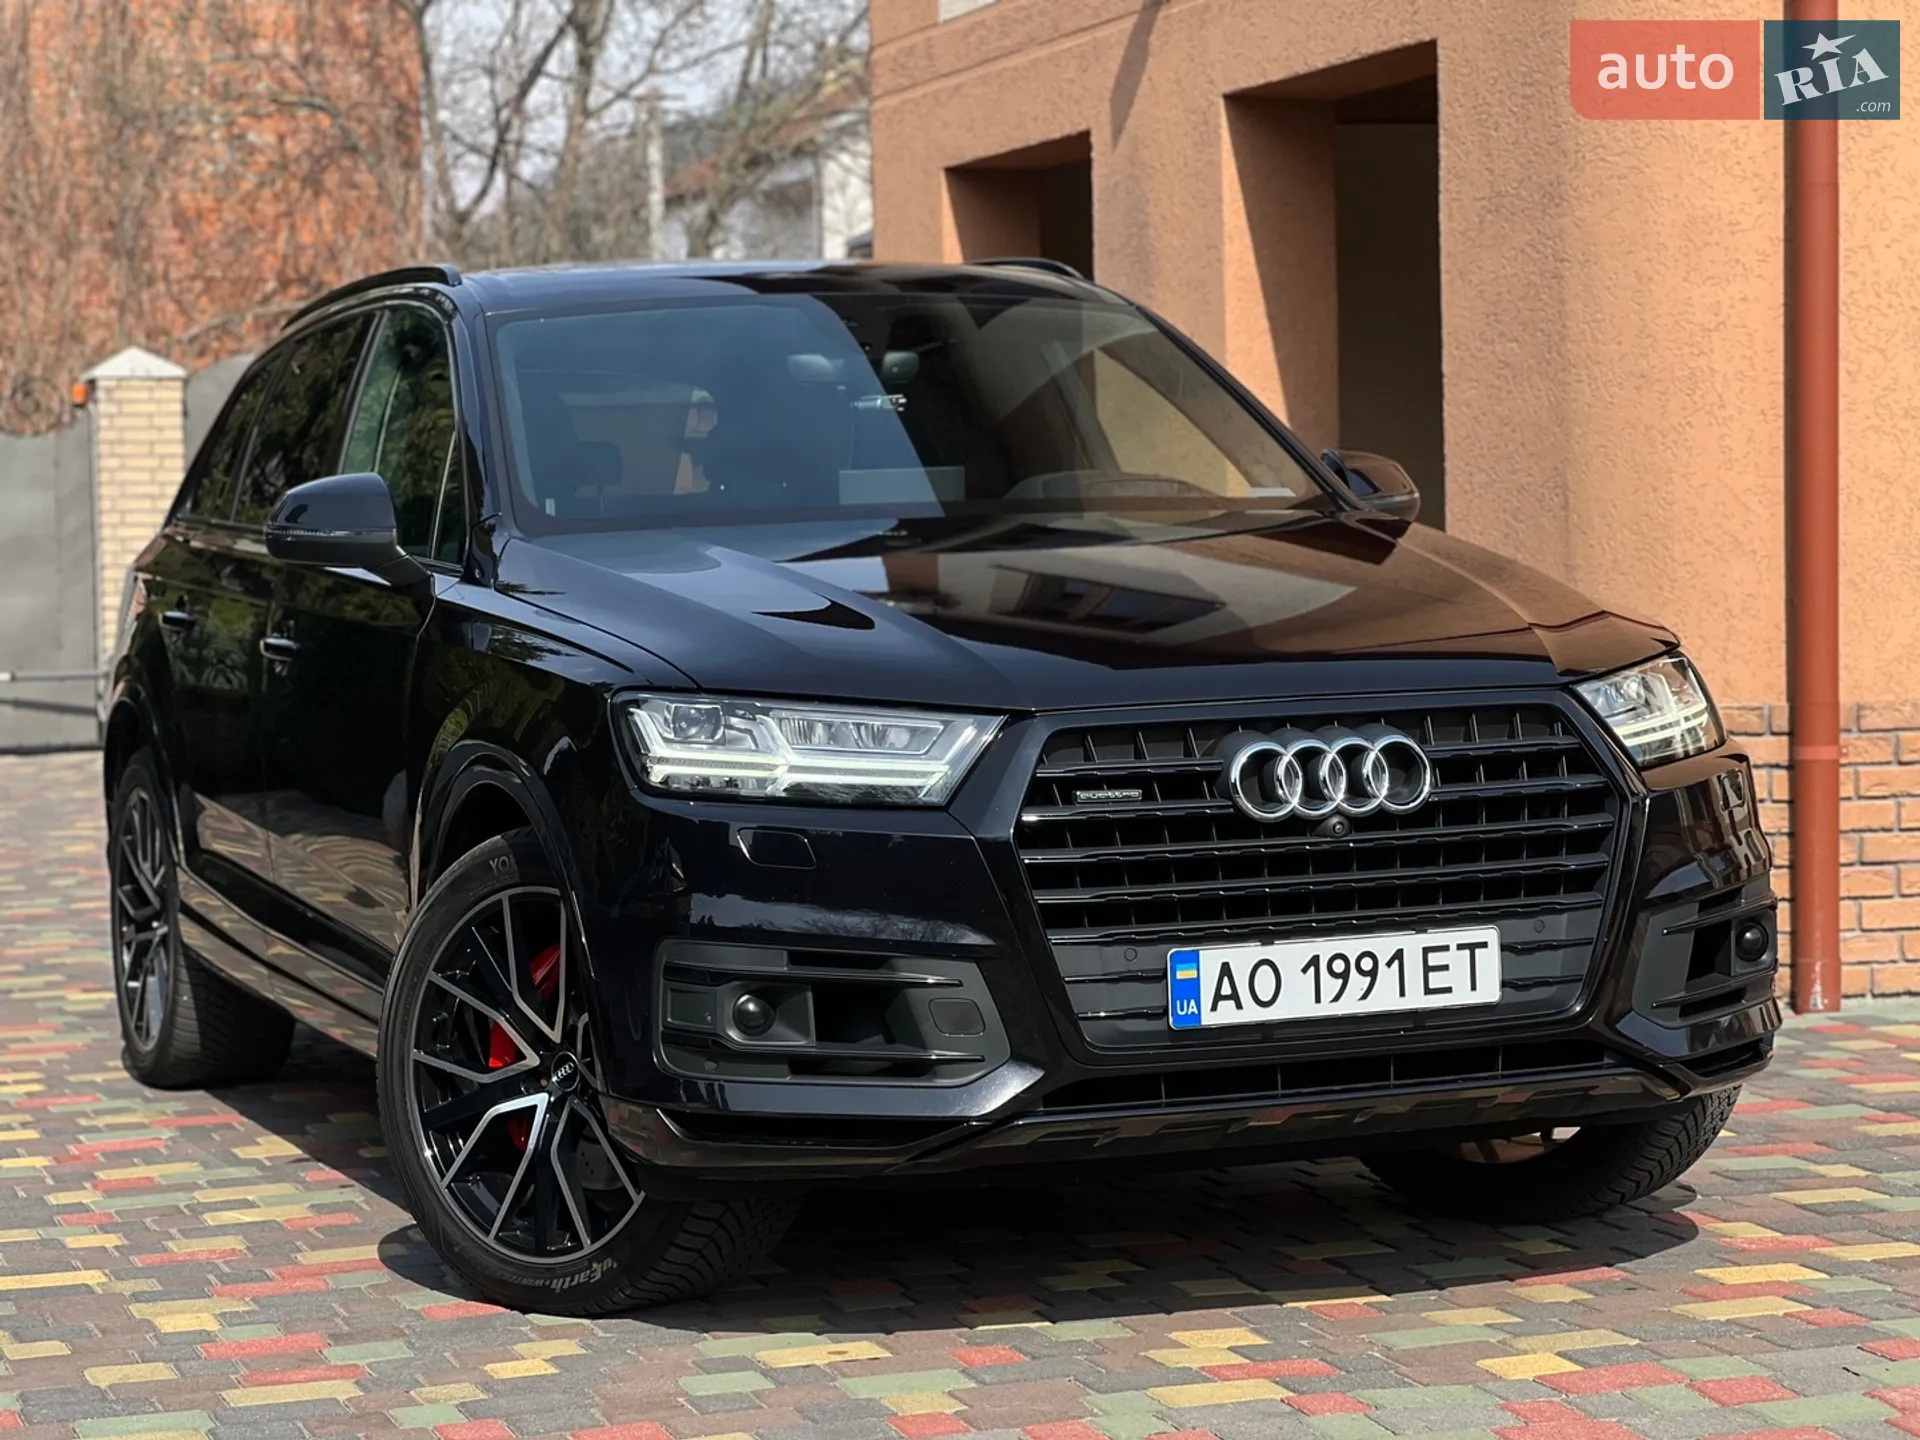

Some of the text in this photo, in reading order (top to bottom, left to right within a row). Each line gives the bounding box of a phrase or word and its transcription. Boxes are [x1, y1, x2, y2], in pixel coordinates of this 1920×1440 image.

[1210, 941, 1489, 1012] AO 1991 ET
[1177, 998, 1199, 1016] UA
